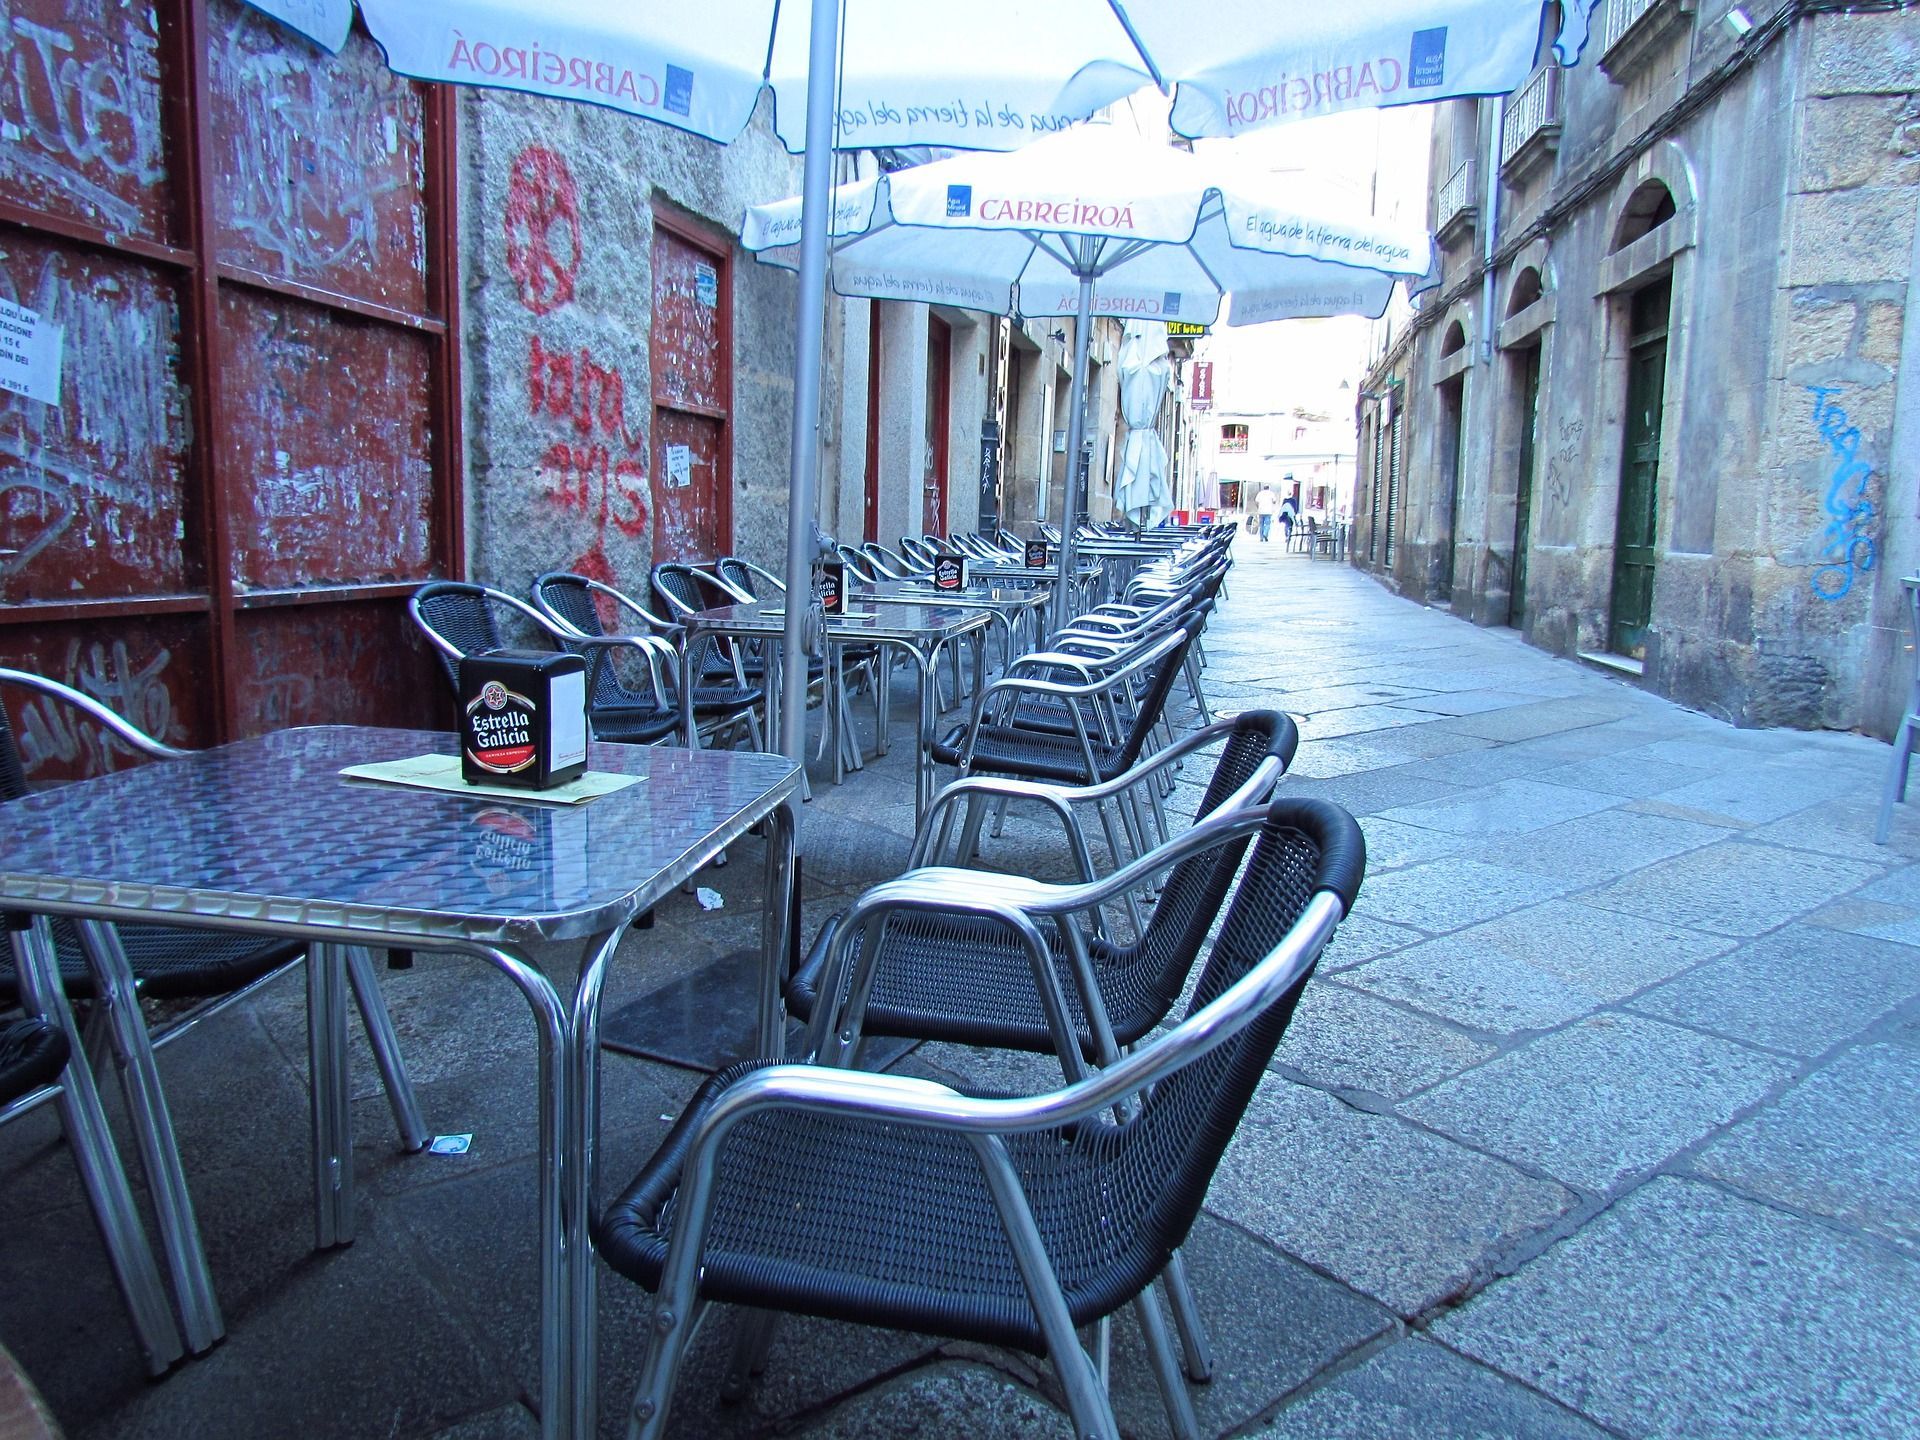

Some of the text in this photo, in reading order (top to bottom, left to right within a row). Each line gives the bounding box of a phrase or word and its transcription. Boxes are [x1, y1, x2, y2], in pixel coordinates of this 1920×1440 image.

[1246, 213, 1410, 263] El agua de la tierra del agua
[472, 711, 530, 732] Estrella
[477, 727, 530, 748] Galicia
